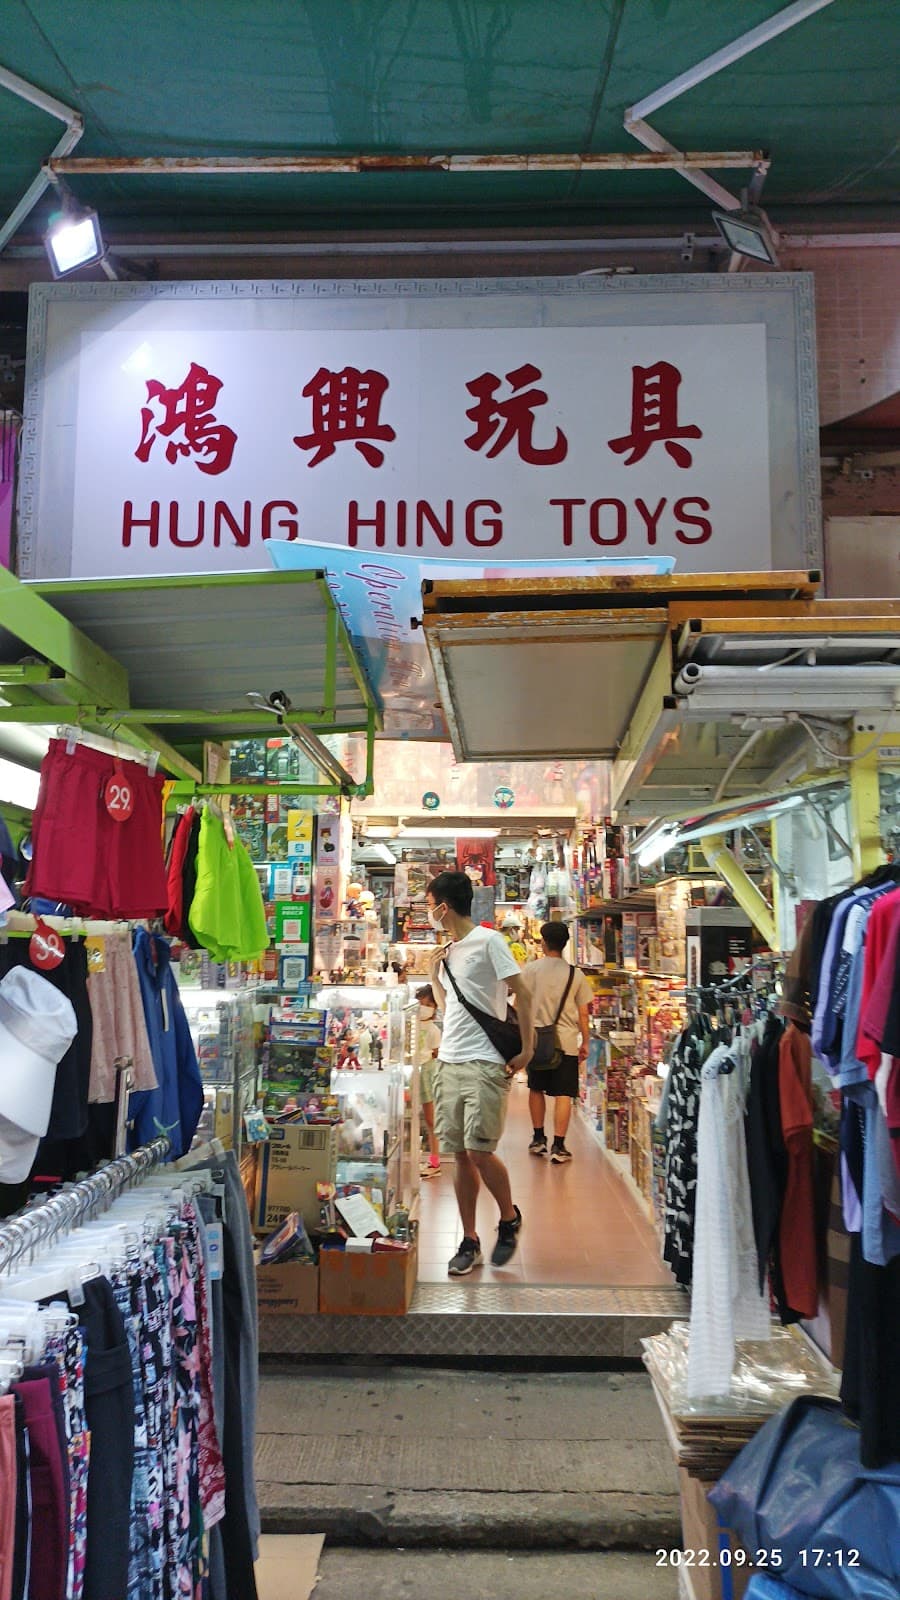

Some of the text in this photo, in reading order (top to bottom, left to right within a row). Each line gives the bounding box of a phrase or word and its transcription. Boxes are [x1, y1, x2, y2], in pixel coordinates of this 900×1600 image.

[135, 361, 702, 475] 鴻興玩具
[122, 497, 712, 547] HUNG HING TOYS
[110, 785, 130, 810] 29
